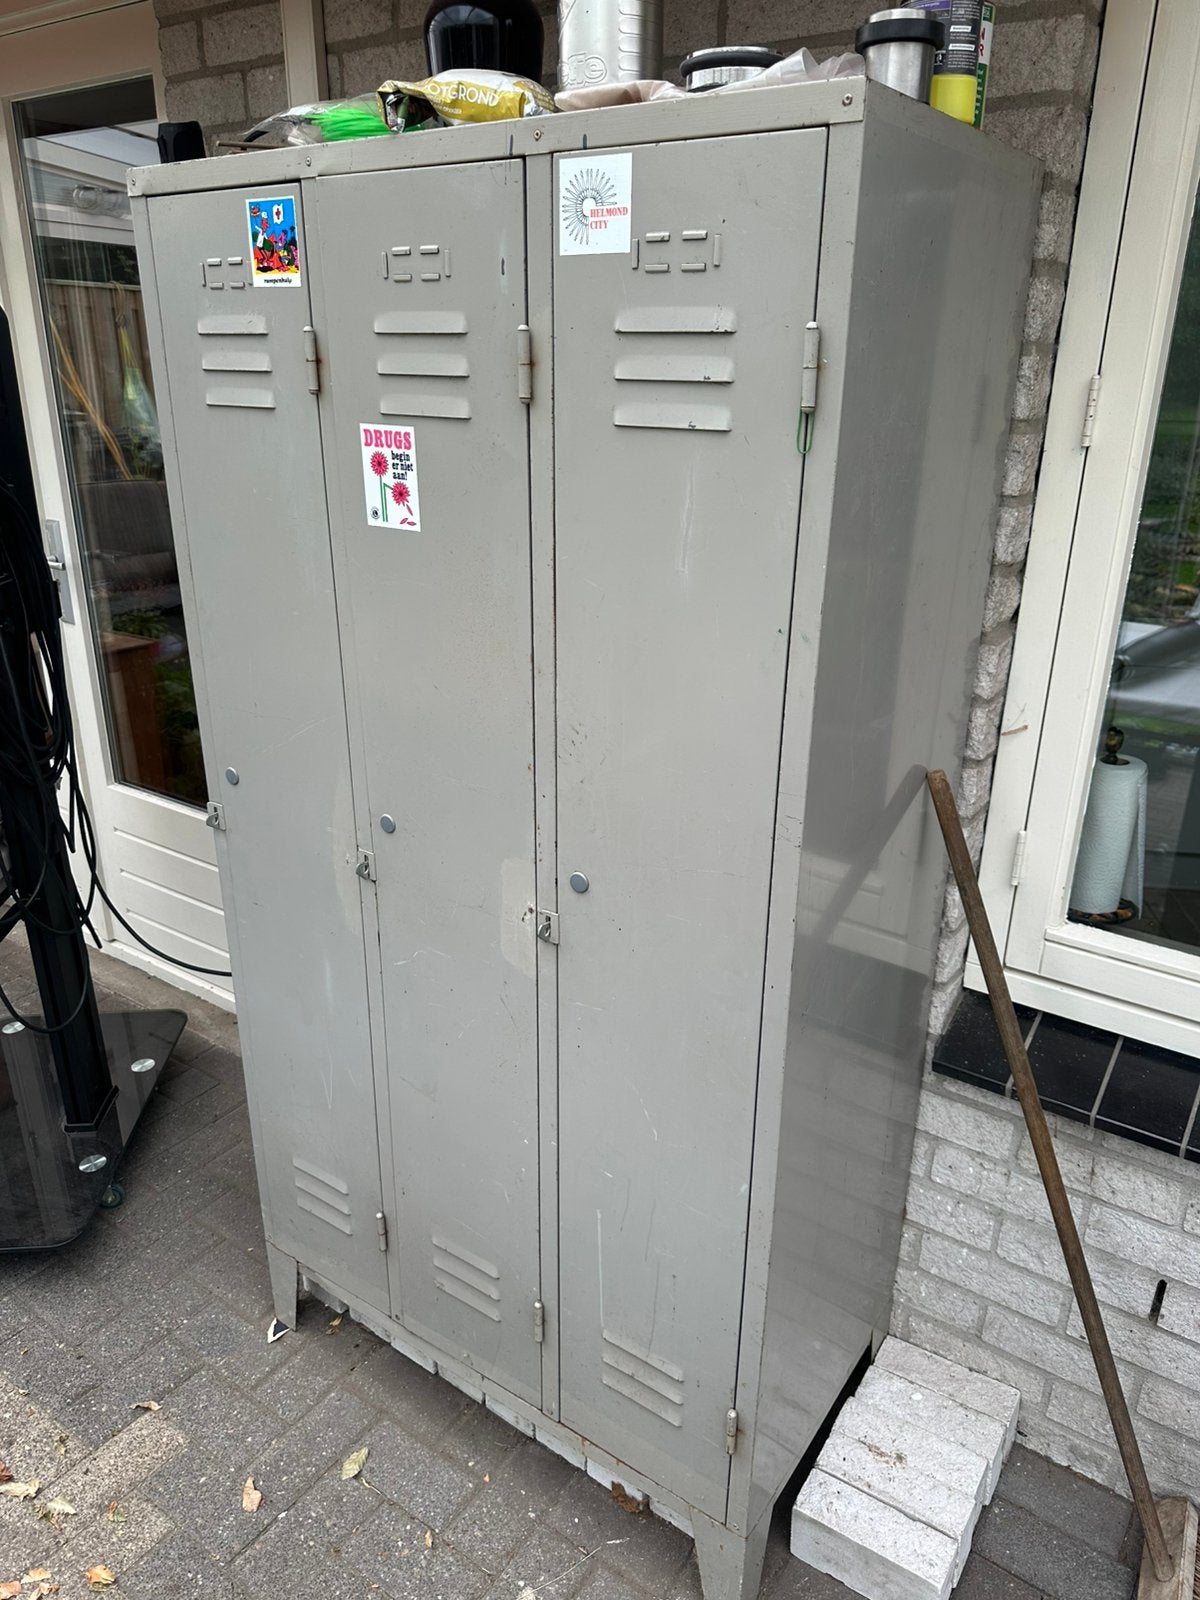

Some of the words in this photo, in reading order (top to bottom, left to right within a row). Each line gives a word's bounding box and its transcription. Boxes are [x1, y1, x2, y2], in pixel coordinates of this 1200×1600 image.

[426, 83, 500, 107] OTGROND
[590, 206, 628, 218] HELMOND
[590, 220, 609, 230] CITY
[363, 428, 412, 451] DRUGS
[391, 450, 410, 462] begin
[392, 462, 399, 470] er
[400, 462, 414, 472] niet
[392, 471, 407, 481] aan!
